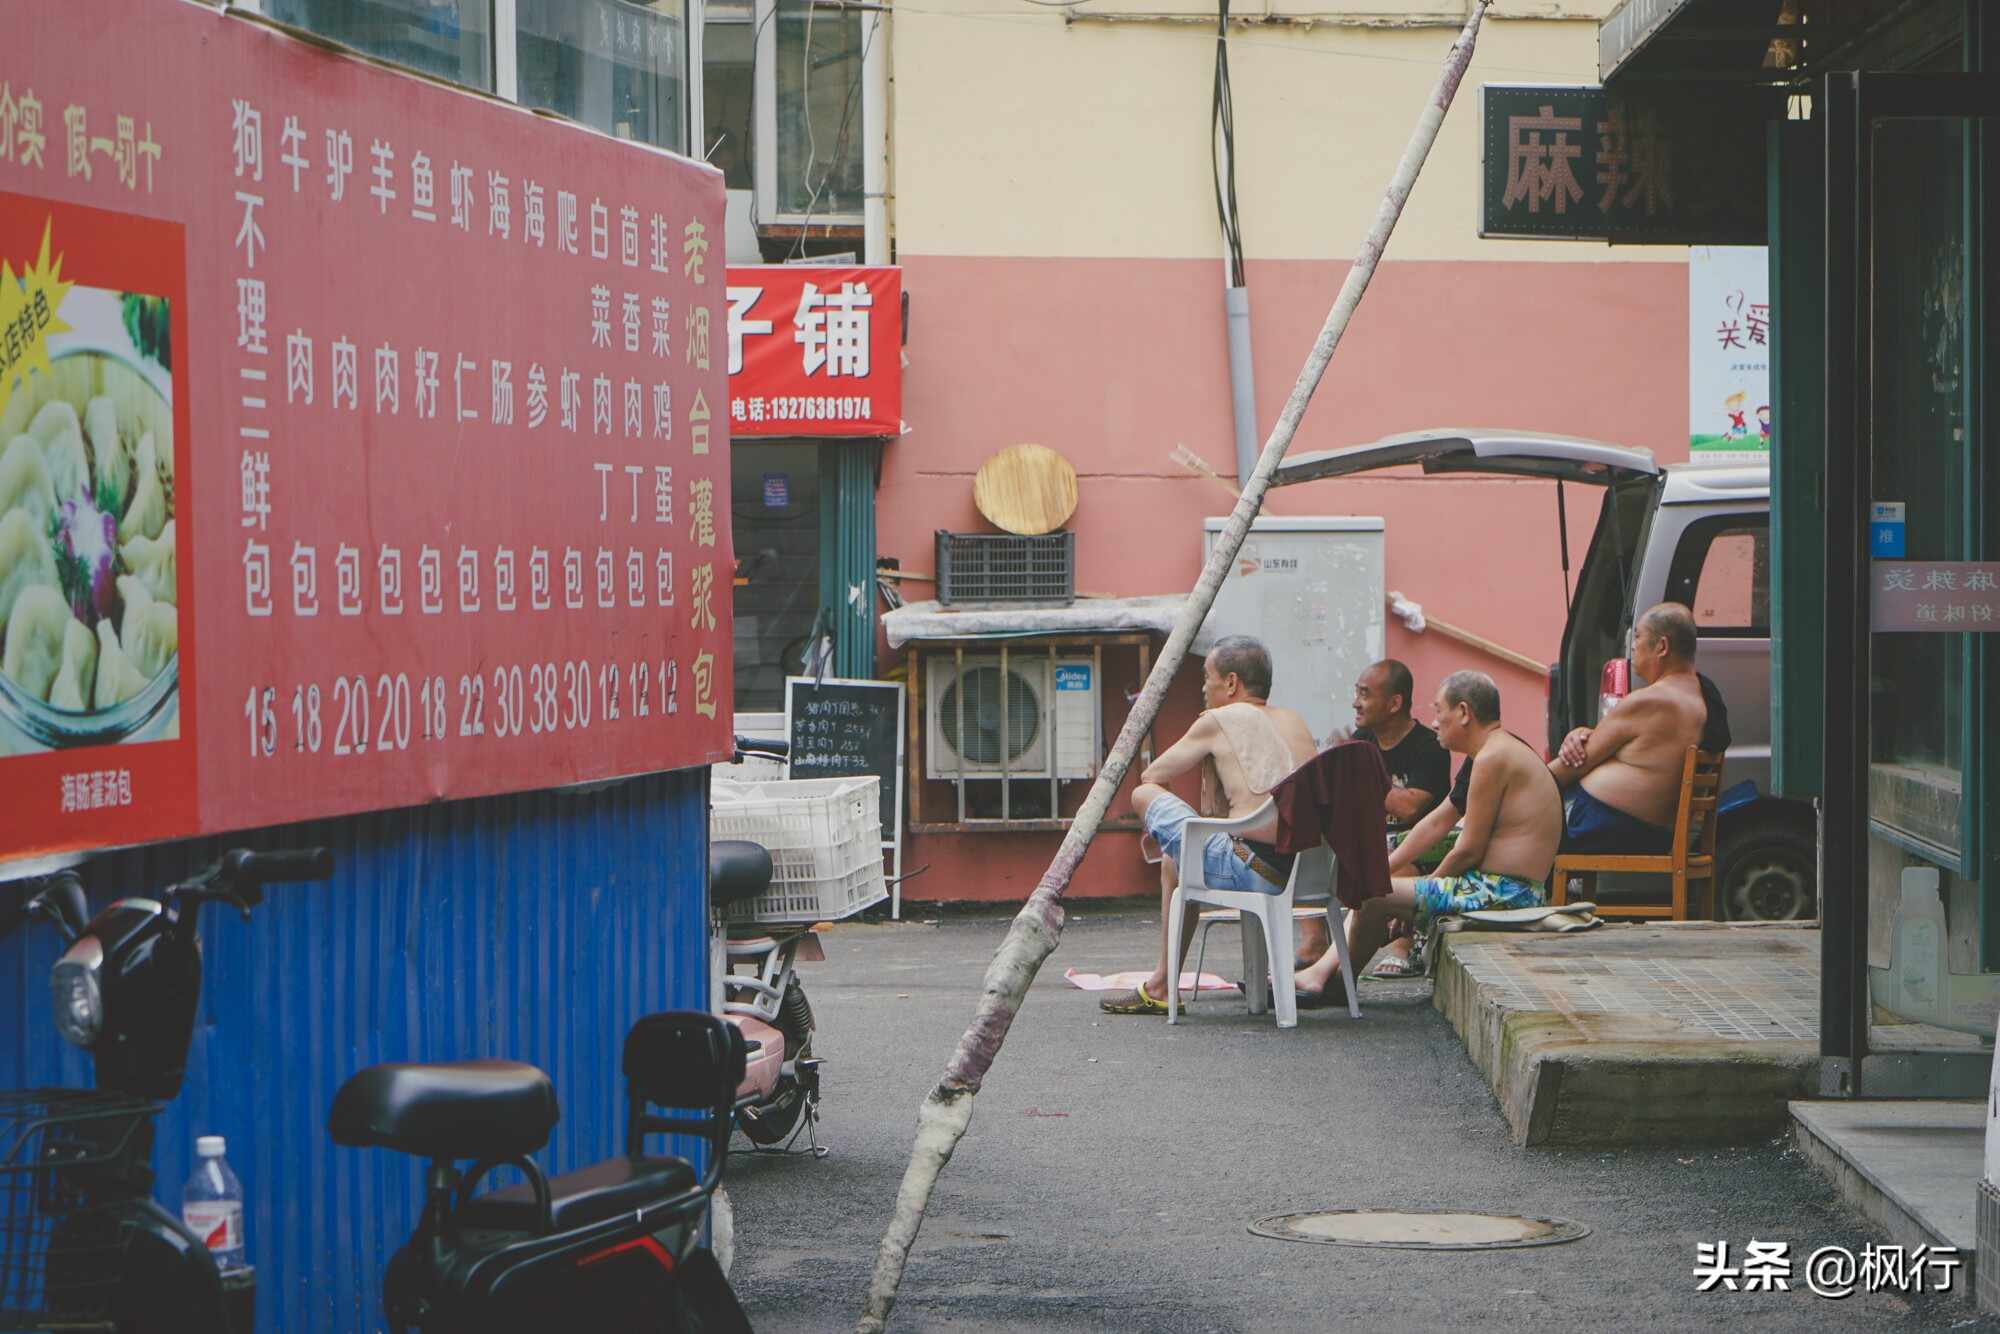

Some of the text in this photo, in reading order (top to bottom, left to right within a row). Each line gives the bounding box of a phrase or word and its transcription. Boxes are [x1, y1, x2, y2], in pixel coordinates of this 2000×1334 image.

[63, 103, 161, 193] 假一罚十
[232, 98, 273, 616] 狗不理三鲜包
[683, 216, 717, 721] 老烟台灌浆包
[245, 686, 276, 757] 15
[292, 683, 322, 753] 18
[334, 675, 369, 756] 20
[377, 672, 410, 752] 20
[420, 676, 446, 741] 18
[459, 674, 485, 737] 22
[493, 664, 524, 738] 30
[529, 662, 559, 734] 38
[563, 659, 591, 730] 30
